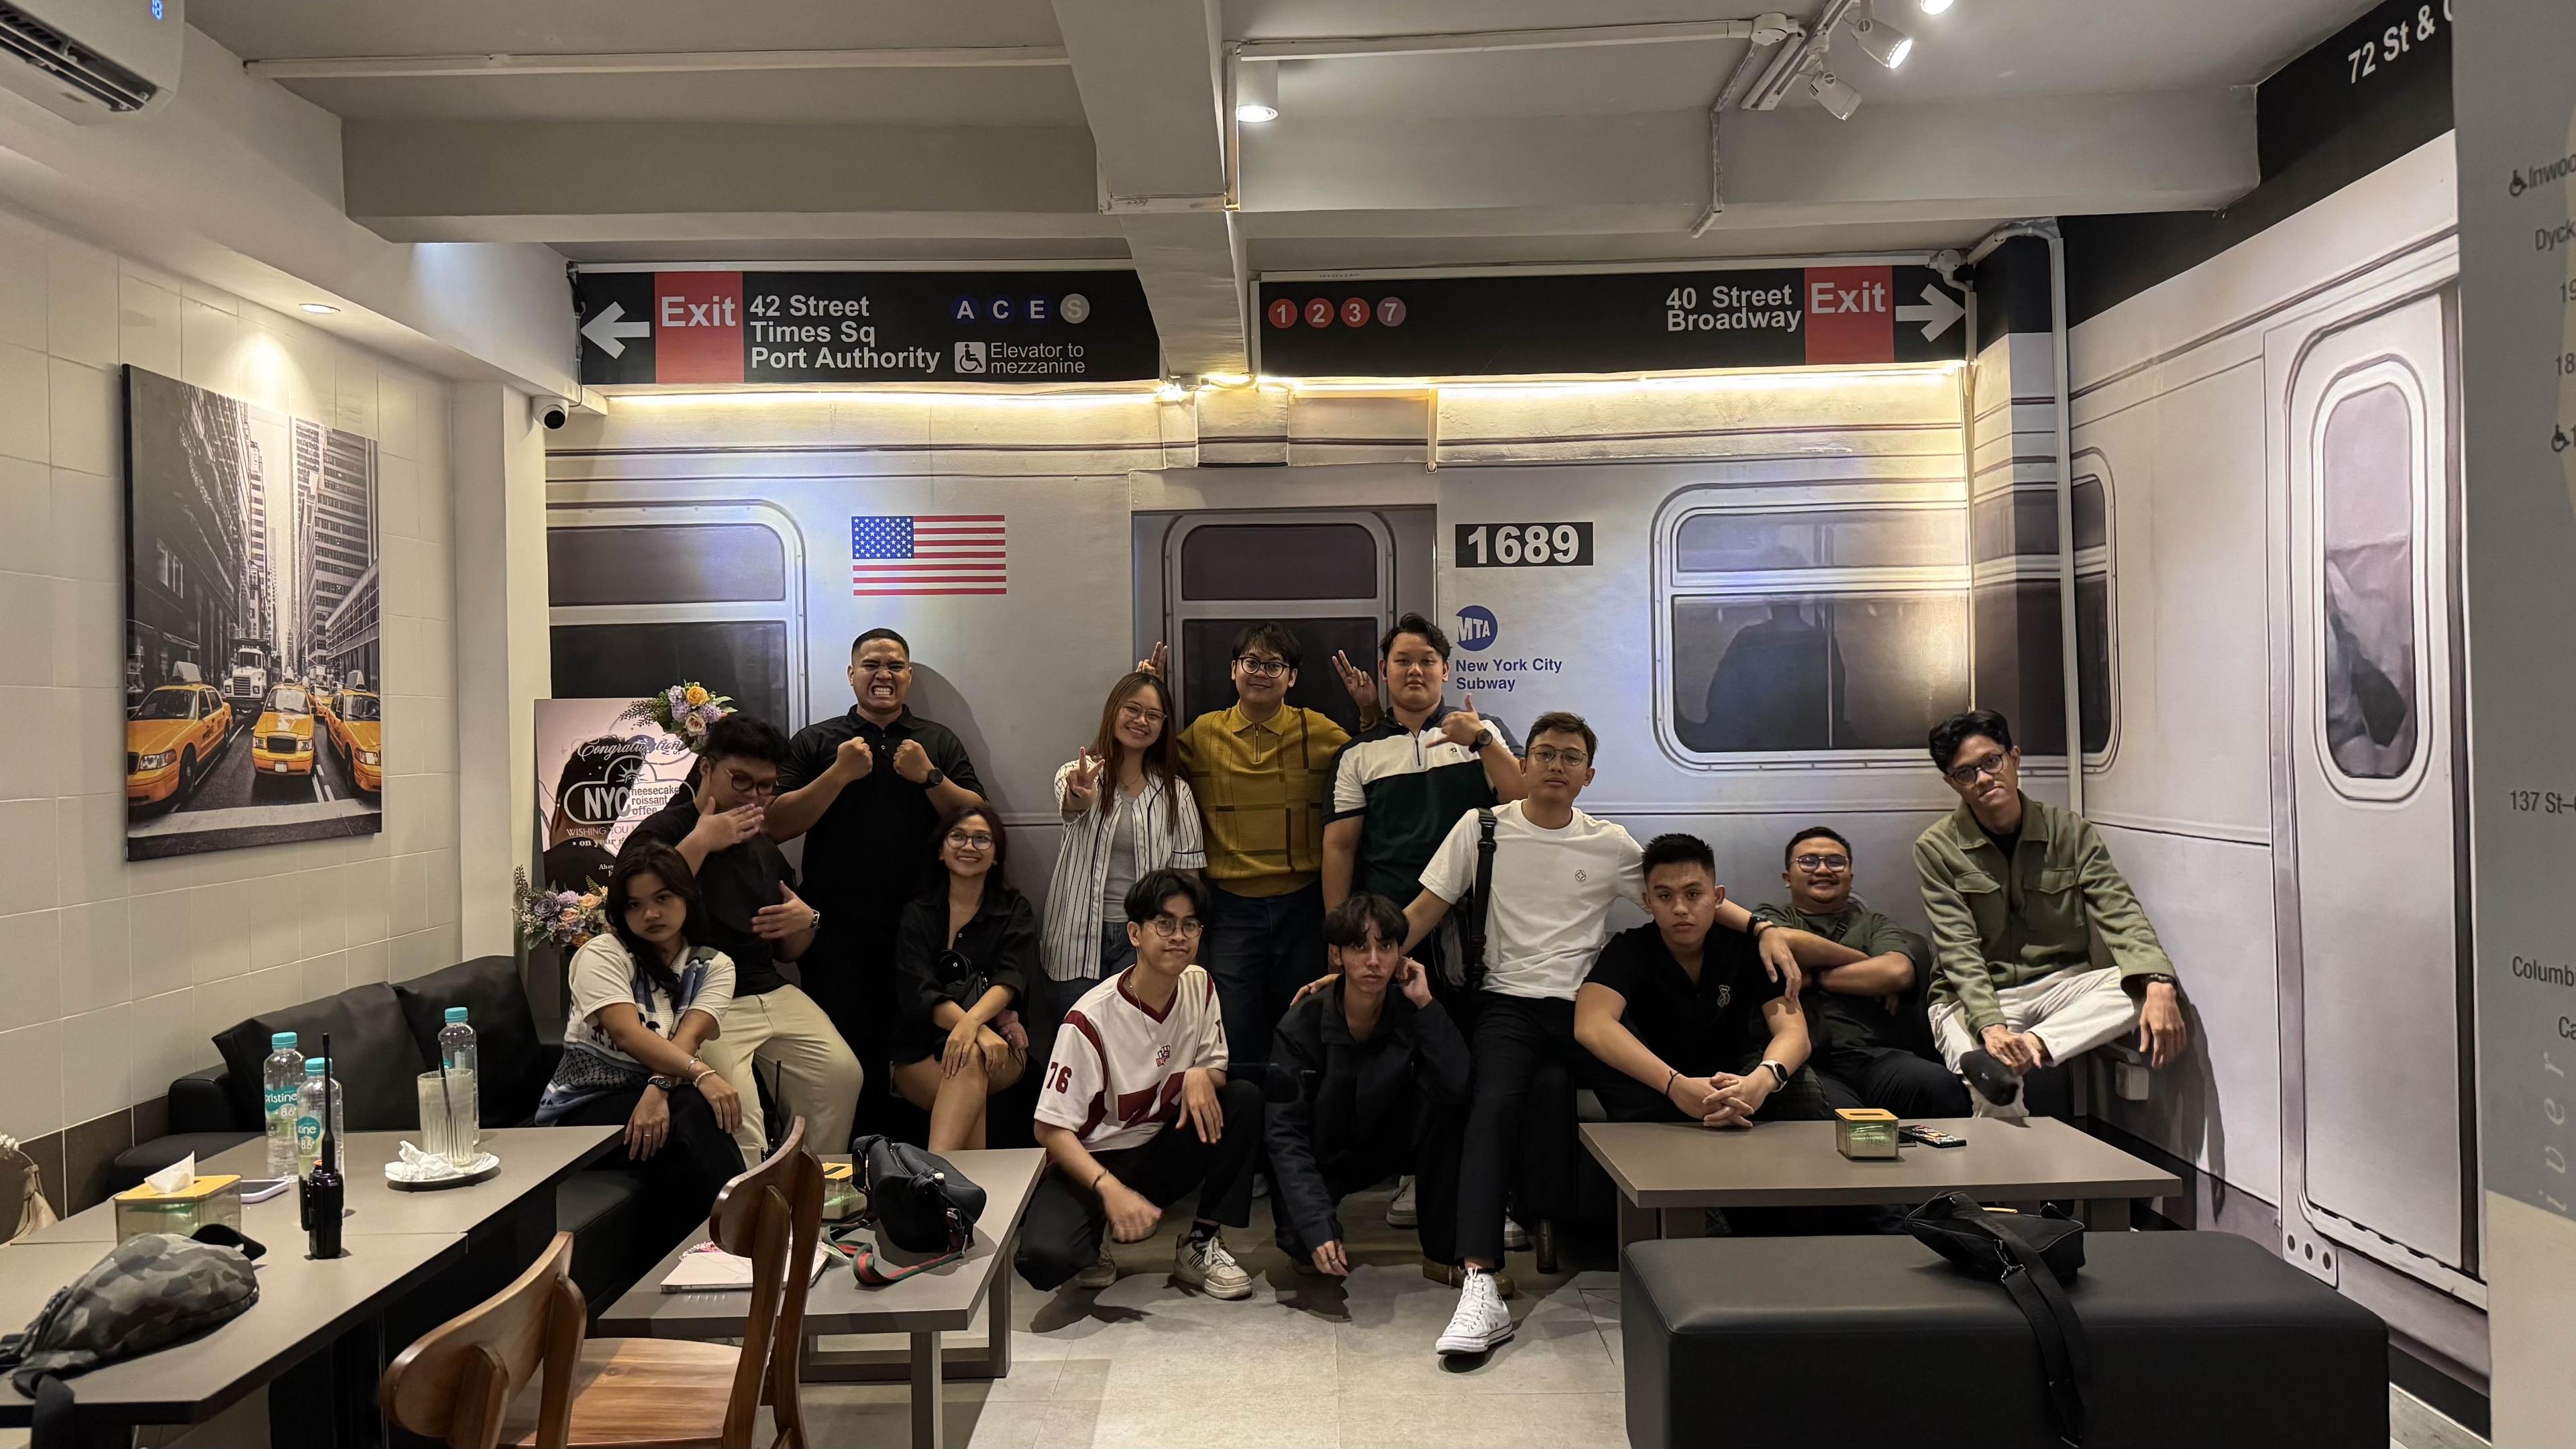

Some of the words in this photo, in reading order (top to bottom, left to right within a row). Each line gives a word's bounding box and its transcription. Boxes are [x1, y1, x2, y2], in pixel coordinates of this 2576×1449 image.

[2348, 41, 2376, 84] 72
[2383, 21, 2410, 62] St
[2416, 5, 2436, 41] &
[661, 295, 737, 327] Exit
[749, 295, 780, 317] 42
[790, 294, 870, 317] Street
[957, 300, 975, 319] A
[993, 300, 1009, 319] C
[1030, 300, 1045, 319] E
[1067, 300, 1082, 320] S
[1666, 287, 1697, 311] 40
[1712, 284, 1792, 307] Street
[1811, 281, 1886, 314] Exit
[1277, 304, 1286, 323] 1
[1312, 304, 1326, 323] 2
[1348, 303, 1361, 323] 3
[1385, 303, 1397, 321] 7
[1666, 306, 1802, 333] Broadway
[749, 321, 831, 343] Times
[840, 321, 875, 348] Sq
[751, 347, 807, 369] Port
[814, 344, 941, 374] Authority
[991, 342, 1063, 358] Elevator
[1067, 343, 1084, 358] to
[991, 361, 1085, 374] mezzanine
[1468, 525, 1579, 564] 1689
[1456, 615, 1491, 642] MTA
[1456, 659, 1489, 672] New
[1493, 658, 1527, 672] York
[1532, 657, 1562, 674] City
[1456, 676, 1516, 692] Subway
[584, 786, 631, 820] NYC
[2510, 790, 2540, 812] 137
[567, 826, 606, 837] WISHING
[1046, 1061, 1073, 1094] 76
